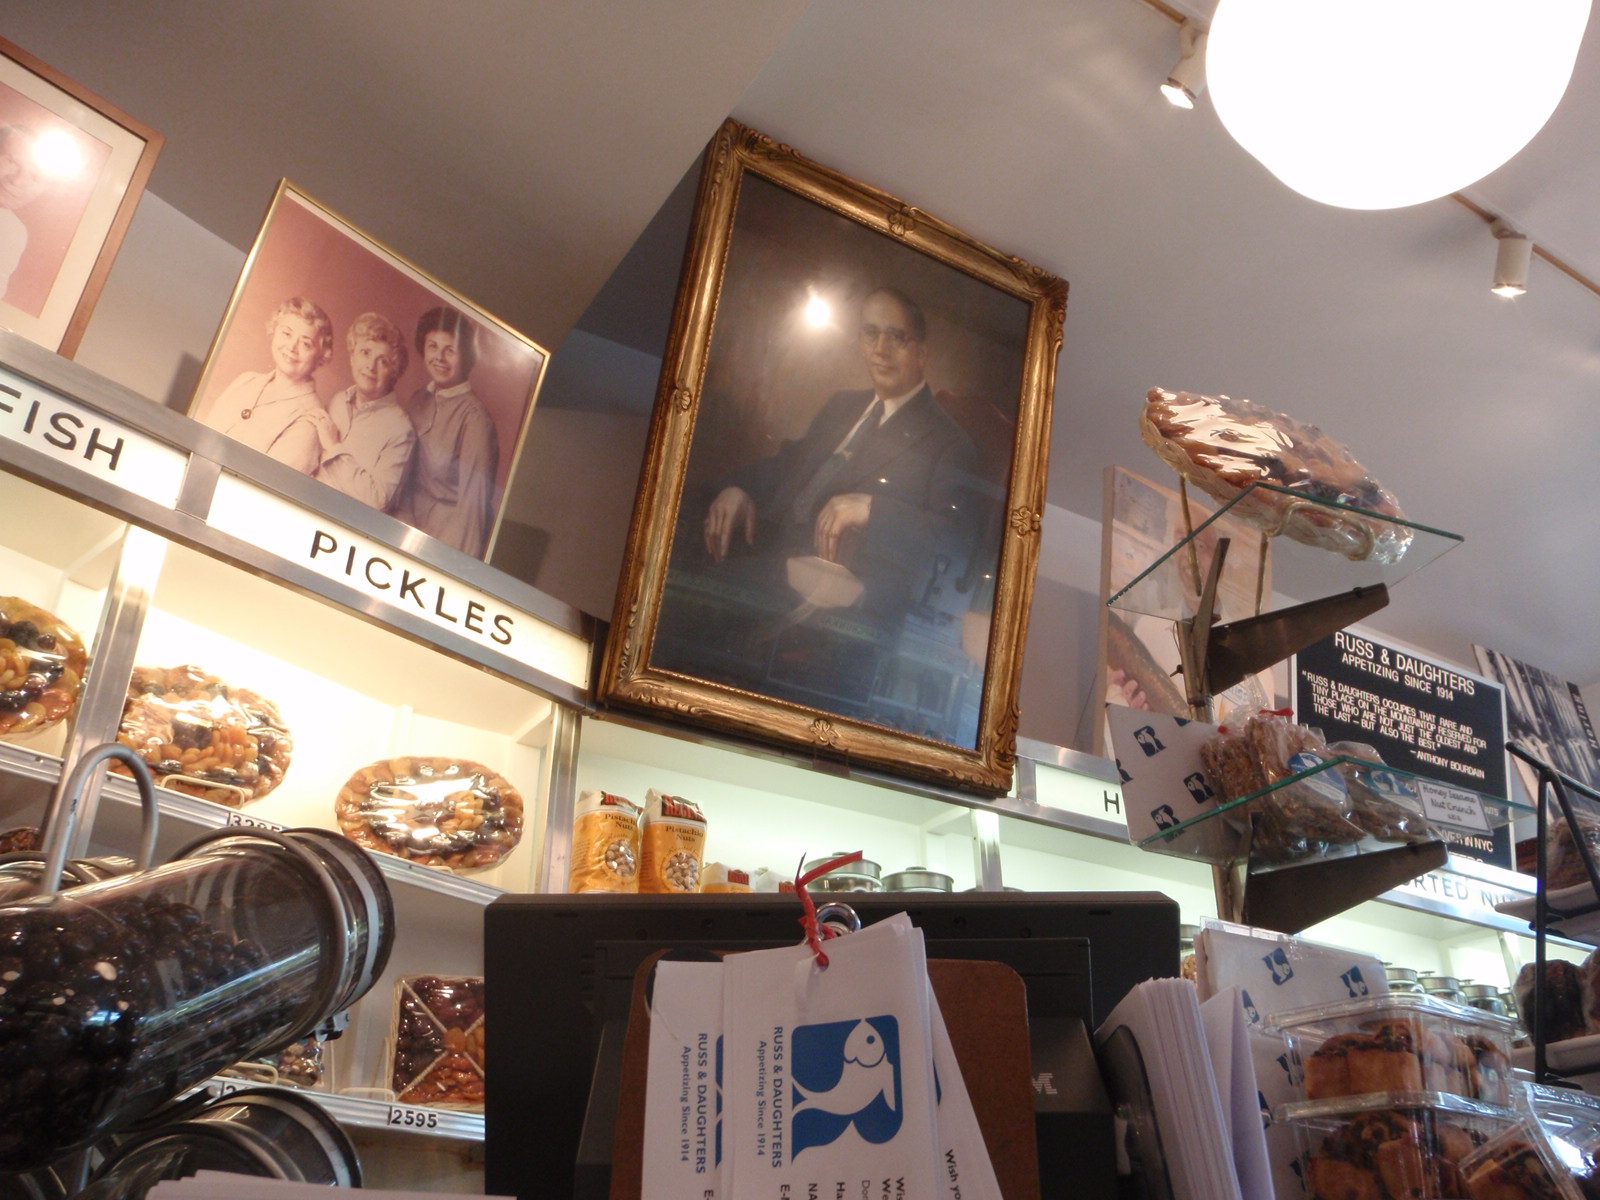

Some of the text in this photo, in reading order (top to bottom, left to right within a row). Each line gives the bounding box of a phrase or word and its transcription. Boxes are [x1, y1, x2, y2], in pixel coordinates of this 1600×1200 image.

[310, 530, 514, 645] PICKLES
[1335, 631, 1475, 695] RUSS & DAUGHTERS
[1341, 652, 1453, 701] APPETIZING SINCE 1914
[1311, 683, 1487, 749] TINY PLACE ON THE MOUNTAINTOP RESERVED FOR
[1312, 693, 1478, 755] THOSE WHO ARE NOT JUST THE OLDEST AND
[1313, 703, 1329, 716] THE
[1333, 710, 1351, 723] LAST
[1361, 718, 1375, 731] BUT
[1380, 725, 1399, 739] ALSO
[1401, 731, 1415, 744] THE
[1338, 683, 1380, 705] DAUGHTERS
[1419, 710, 1436, 723] THAT
[1440, 717, 1457, 729] RARE
[1460, 724, 1473, 736] AND
[1450, 761, 1485, 779] BOURDAIN
[1474, 837, 1494, 853] NYC
[391, 1109, 437, 1128] 2595
[680, 1046, 691, 1161] Appetizing Since 1914
[695, 1033, 708, 1174] RUSS & DAUGHTERS
[756, 1040, 767, 1156] Appetizing Since 1914
[771, 1026, 784, 1168] RUSS & DAUGHTERS
[945, 1149, 959, 1182] Wish
